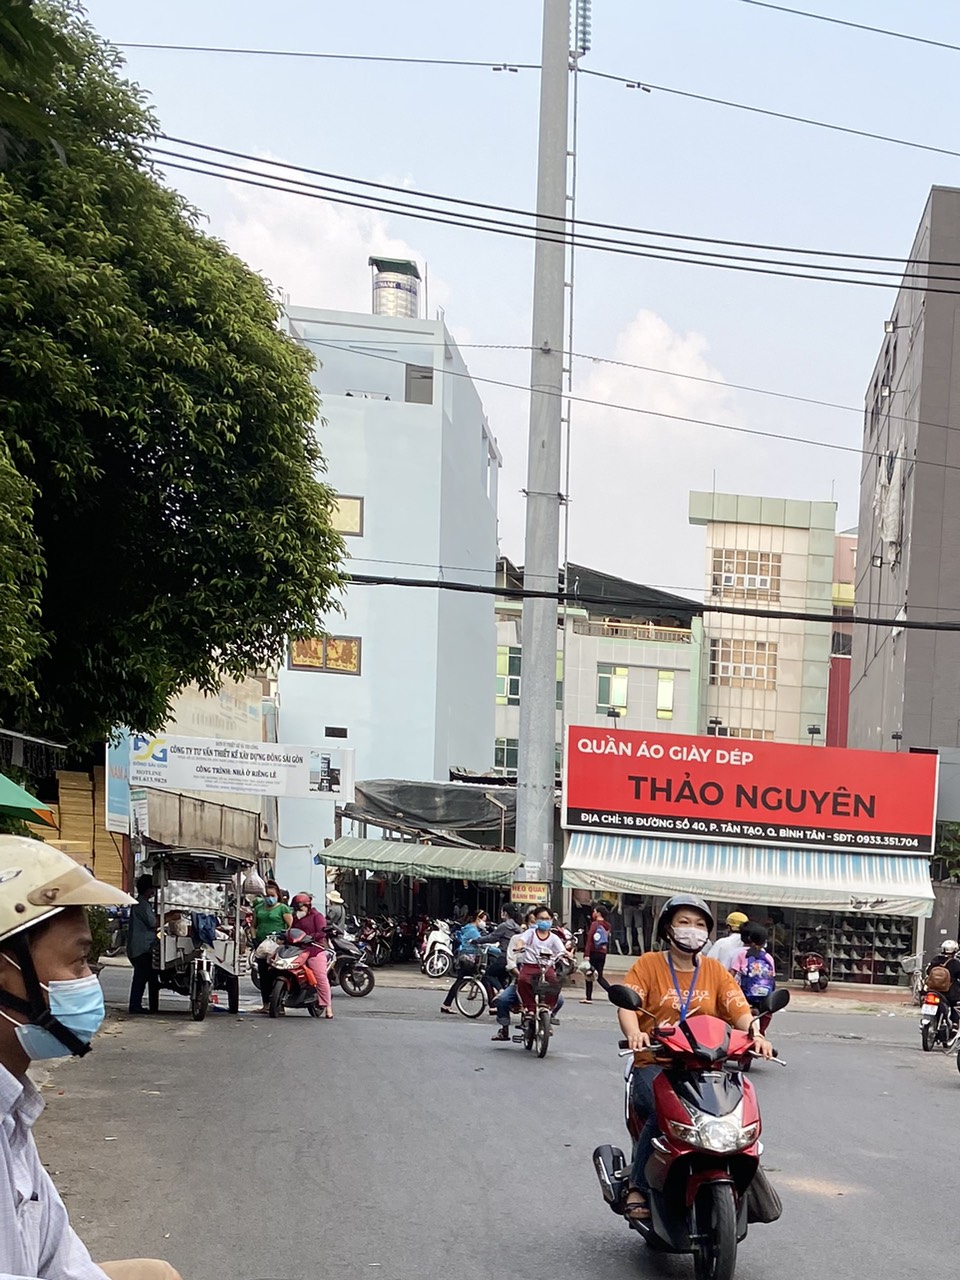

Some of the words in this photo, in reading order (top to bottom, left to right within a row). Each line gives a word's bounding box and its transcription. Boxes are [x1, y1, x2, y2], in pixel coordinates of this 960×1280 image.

[170, 746, 185, 754] CÔNG
[194, 748, 202, 756] TƯ
[203, 747, 213, 756] VẤN
[214, 748, 230, 758] THIẾT
[231, 750, 238, 758] KẾ
[240, 751, 249, 759] XÂY
[250, 752, 266, 761] DỰNG
[267, 753, 282, 762] ĐÔNG
[282, 754, 291, 763] SÀI
[292, 755, 303, 764] GÒN
[578, 734, 632, 757] QUẦN
[636, 741, 664, 758] ÁO
[669, 744, 712, 762] GIÀY
[716, 748, 754, 766] DÉP
[196, 765, 211, 773] CÔNG
[232, 768, 244, 776] NHÀ
[252, 770, 268, 778] RIÊNG
[628, 772, 724, 806] THẢO
[736, 784, 876, 818] NGUYÊN
[580, 813, 599, 824] ĐỊA
[601, 814, 622, 824] CHỈ:
[623, 816, 634, 825] 16
[636, 816, 674, 828] ĐƯỜNG
[675, 818, 690, 830] SỐ
[692, 821, 708, 832] 40,
[710, 823, 719, 832] P.
[721, 822, 741, 834] TÂN
[742, 825, 765, 836] TẠO,
[766, 828, 777, 837] Q.
[780, 827, 804, 839] BÌNH
[805, 829, 826, 840] TÂN
[833, 832, 855, 842] SĐT:
[856, 836, 918, 847] 0933.351.704
